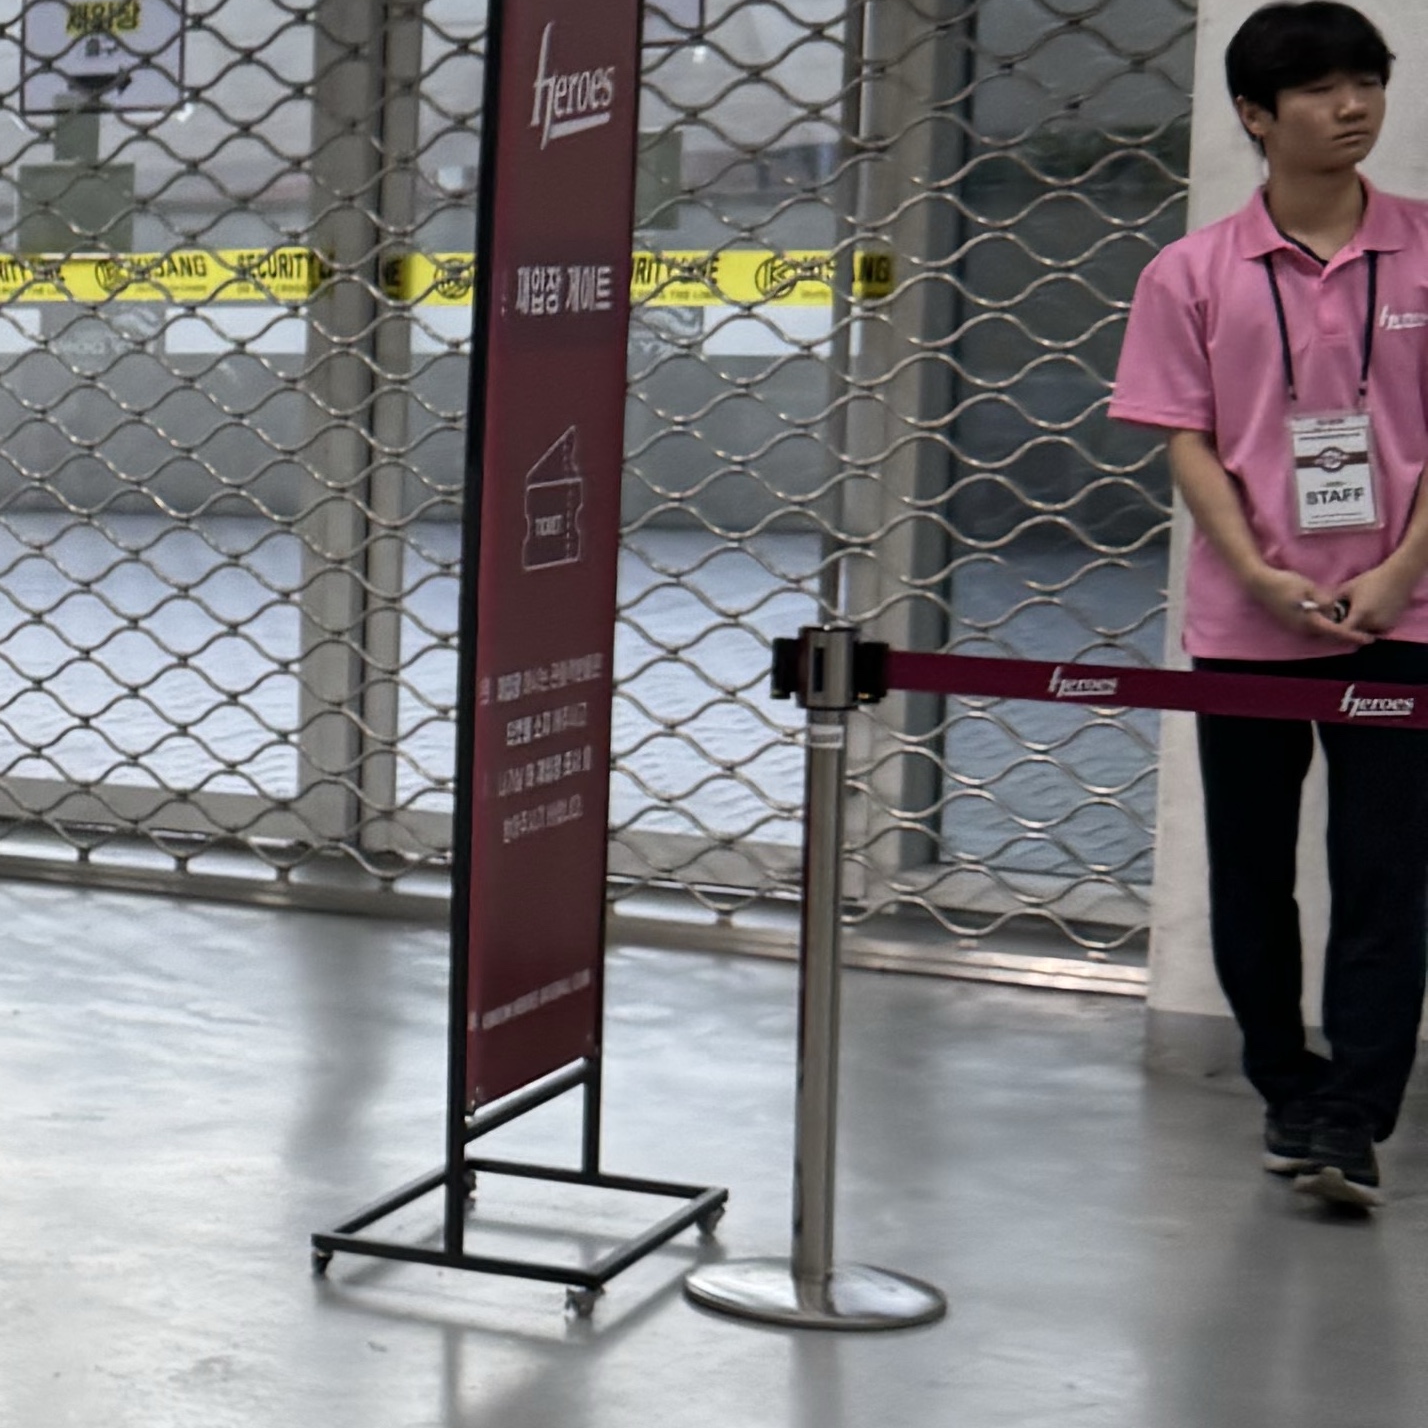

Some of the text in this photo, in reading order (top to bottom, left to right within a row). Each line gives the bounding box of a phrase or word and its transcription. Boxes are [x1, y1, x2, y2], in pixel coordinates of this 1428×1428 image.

[528, 20, 615, 150] heroes
[565, 266, 612, 313] 게이트
[1306, 487, 1364, 505] STAFF
[1048, 666, 1119, 698] heroes
[1340, 683, 1415, 719] heroes
